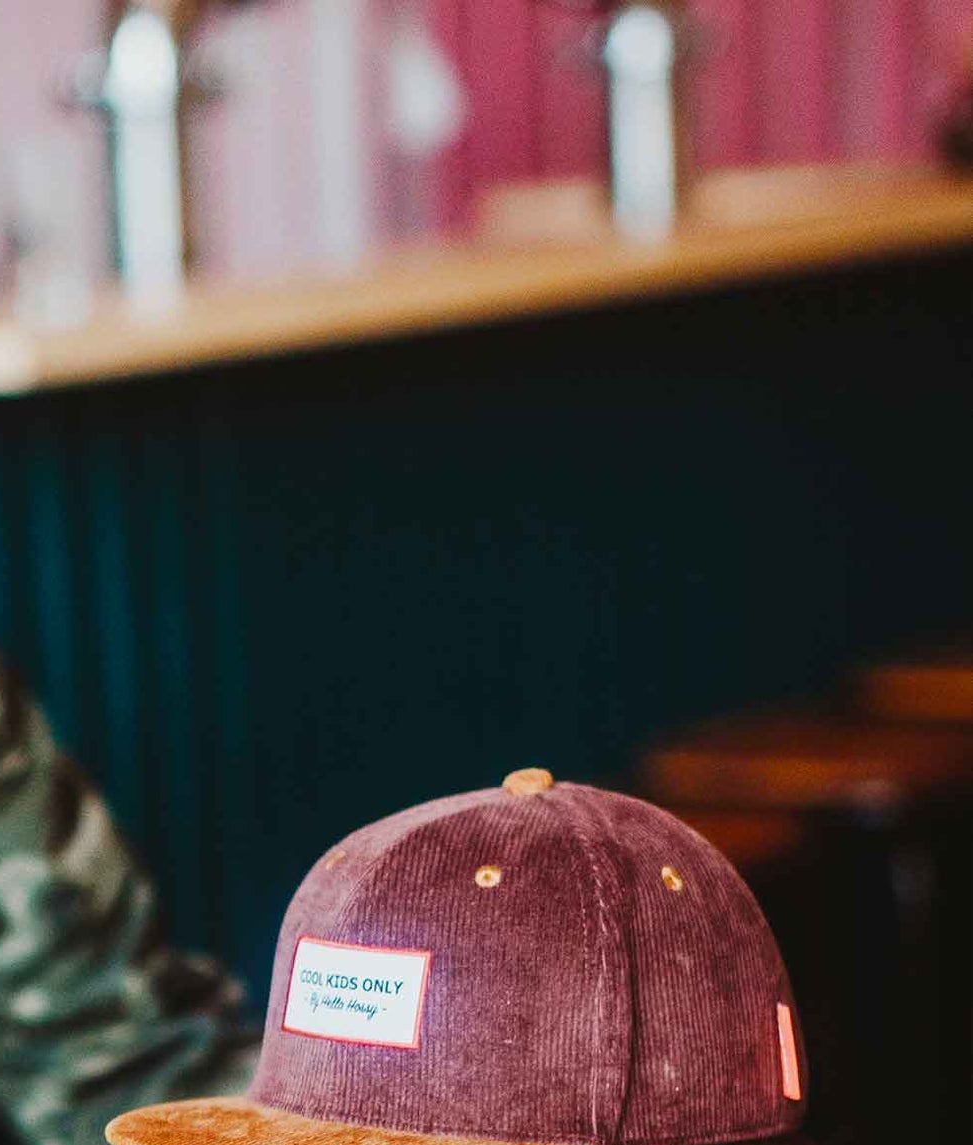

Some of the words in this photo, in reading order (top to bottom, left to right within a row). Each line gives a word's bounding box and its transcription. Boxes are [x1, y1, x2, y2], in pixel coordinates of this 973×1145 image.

[301, 969, 323, 986] COOL
[326, 974, 358, 990] KIDS
[362, 978, 403, 994] ONLY
[321, 995, 344, 1010] Hello
